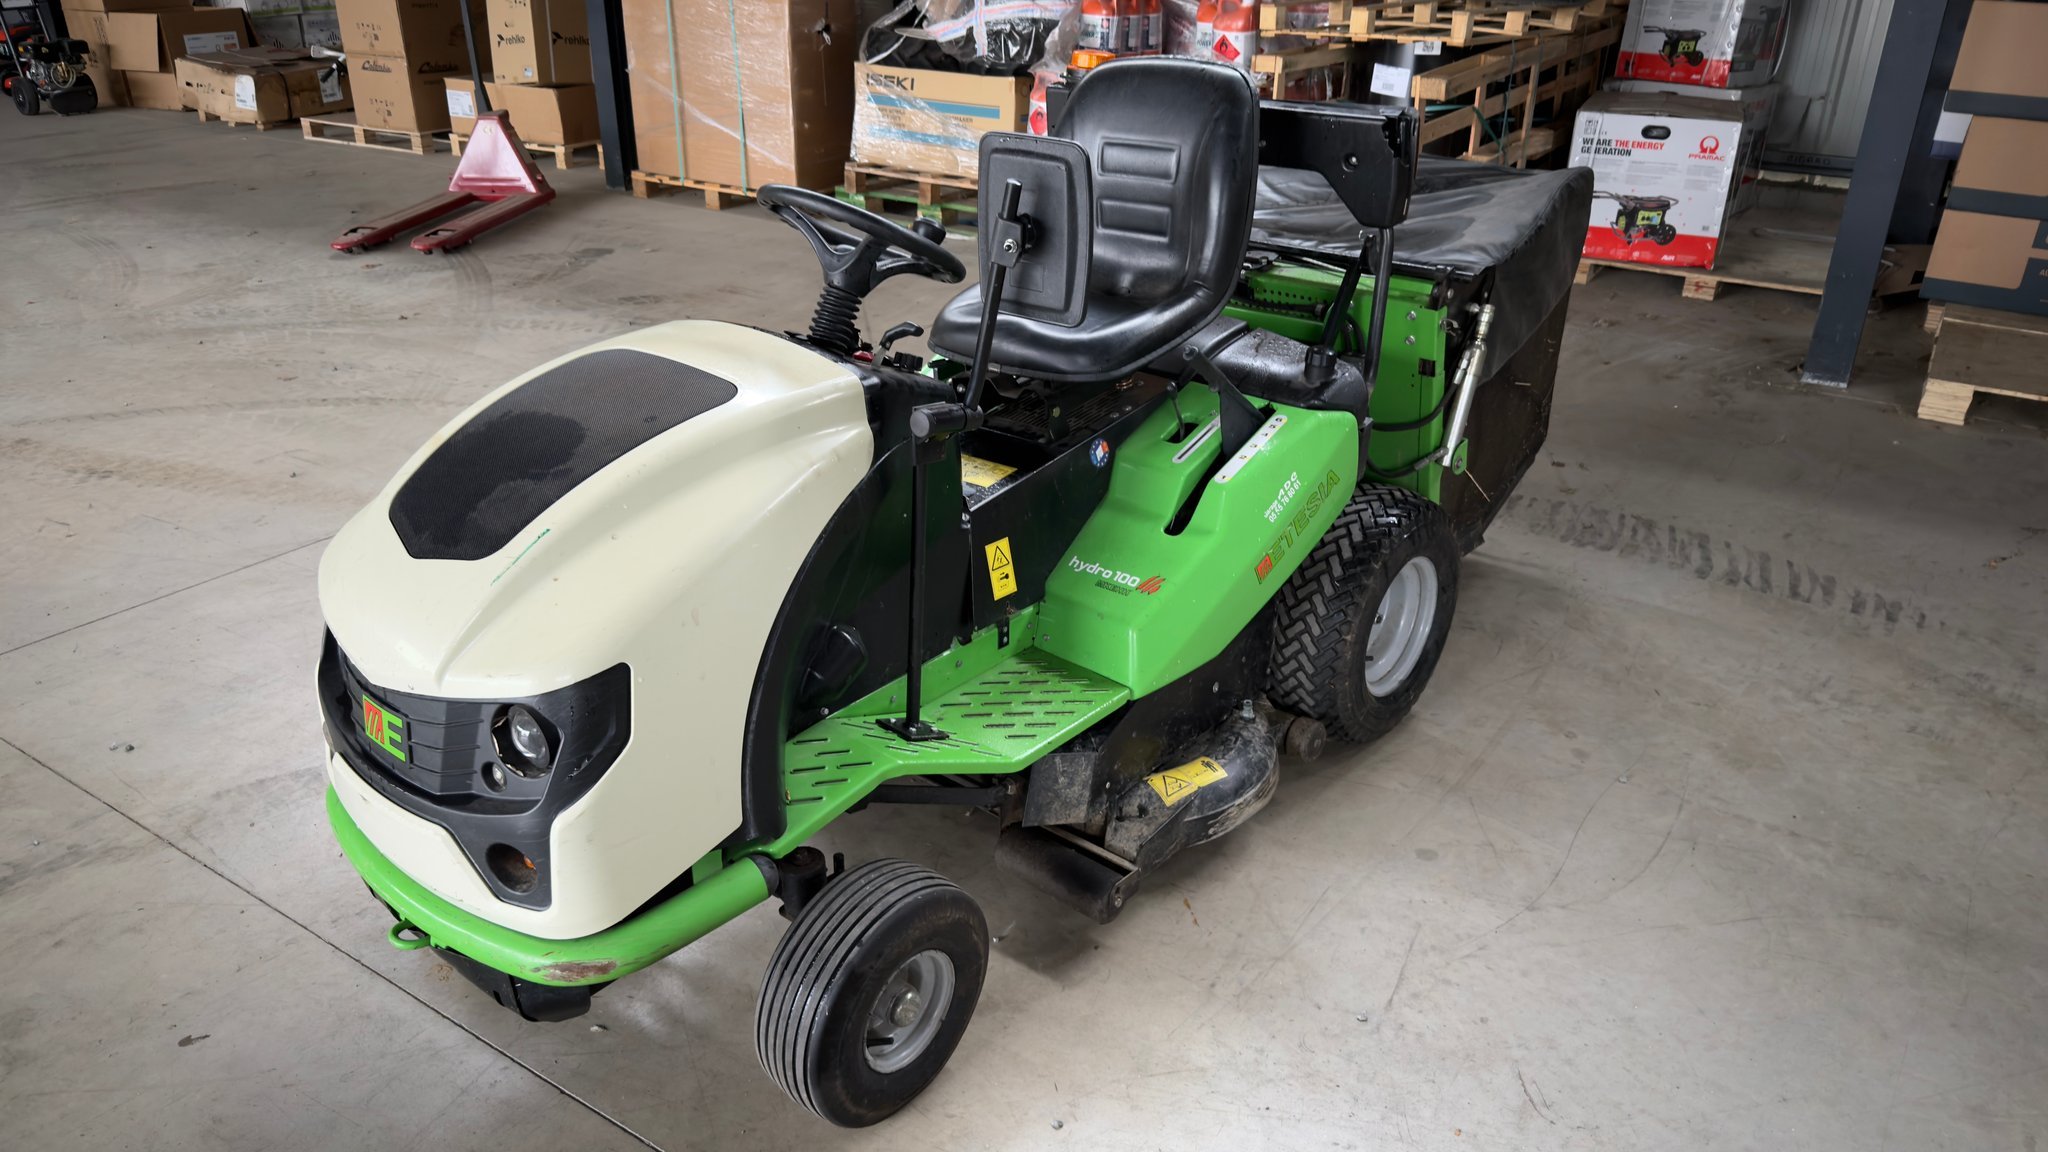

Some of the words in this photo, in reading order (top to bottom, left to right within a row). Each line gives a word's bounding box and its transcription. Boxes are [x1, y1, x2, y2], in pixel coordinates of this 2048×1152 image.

[505, 34, 526, 45] rehlko
[866, 73, 915, 91] ISEKI
[1596, 138, 1613, 147] ARE
[1615, 139, 1630, 148] THE
[1631, 140, 1665, 150] ENERGY
[1688, 153, 1726, 162] PRAMAC
[1068, 555, 1113, 578] hydro
[1113, 571, 1141, 588] 100
